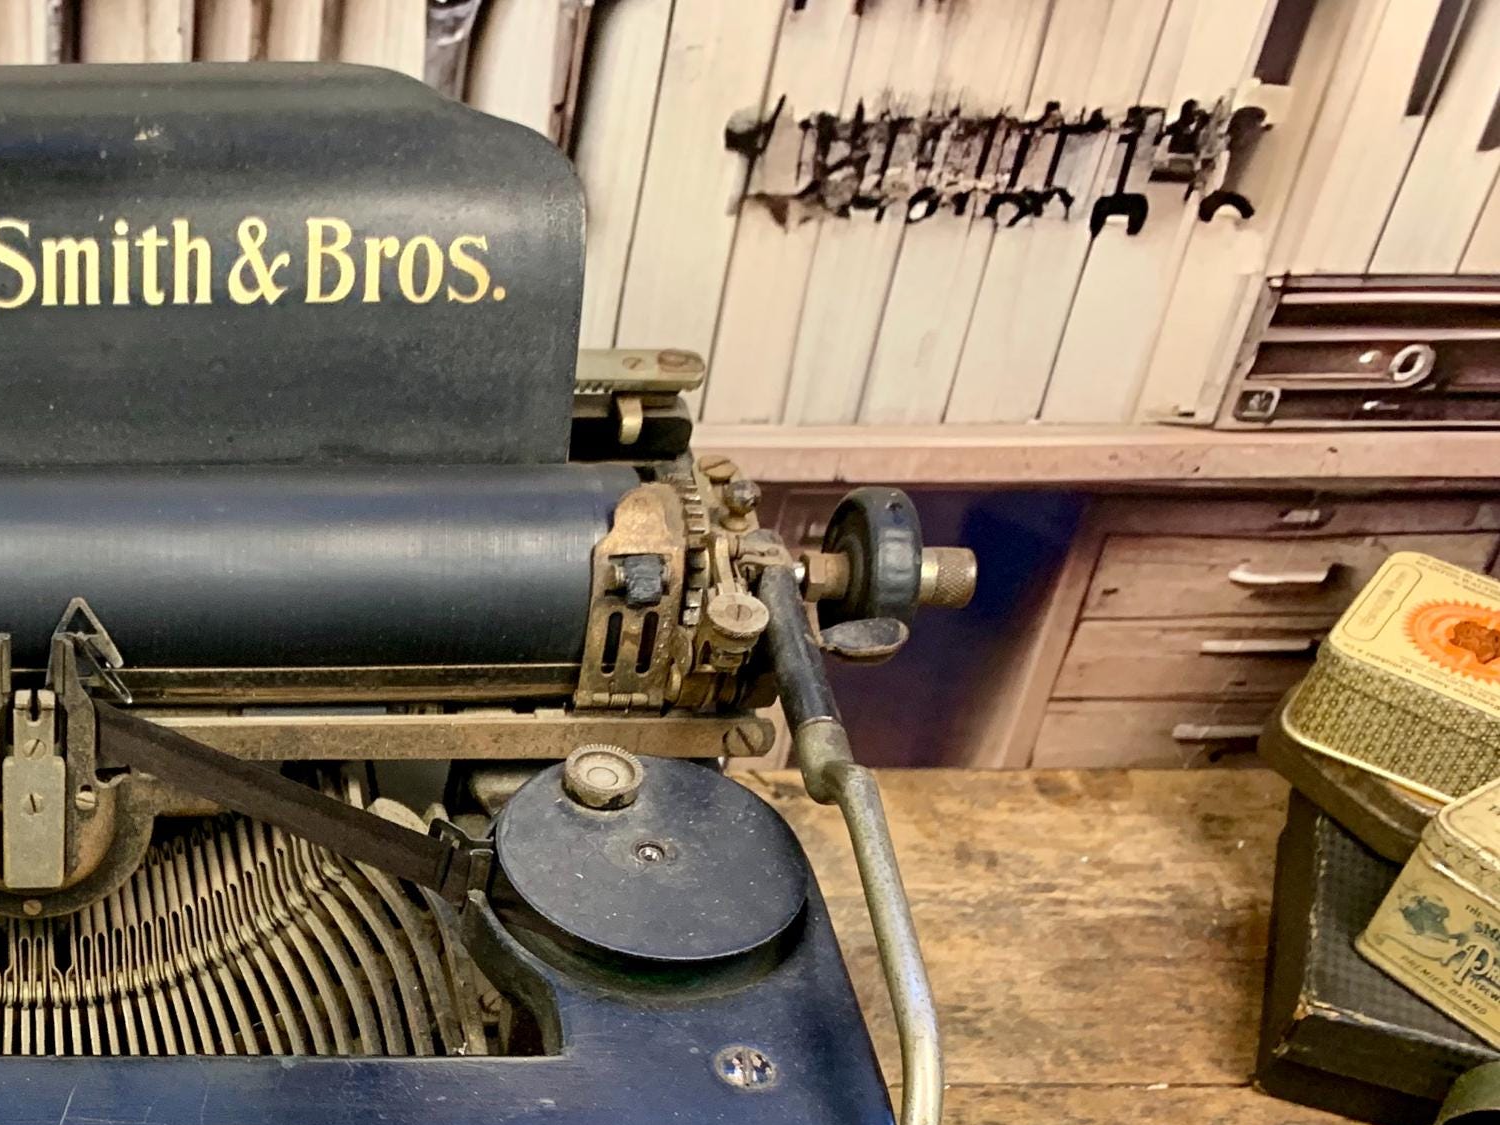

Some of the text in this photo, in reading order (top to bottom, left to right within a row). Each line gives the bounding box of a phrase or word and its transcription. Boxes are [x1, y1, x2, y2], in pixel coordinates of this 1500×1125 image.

[227, 214, 290, 306] &
[304, 216, 507, 304] Bros.
[1401, 953, 1486, 1016] PREMIER BRAND
